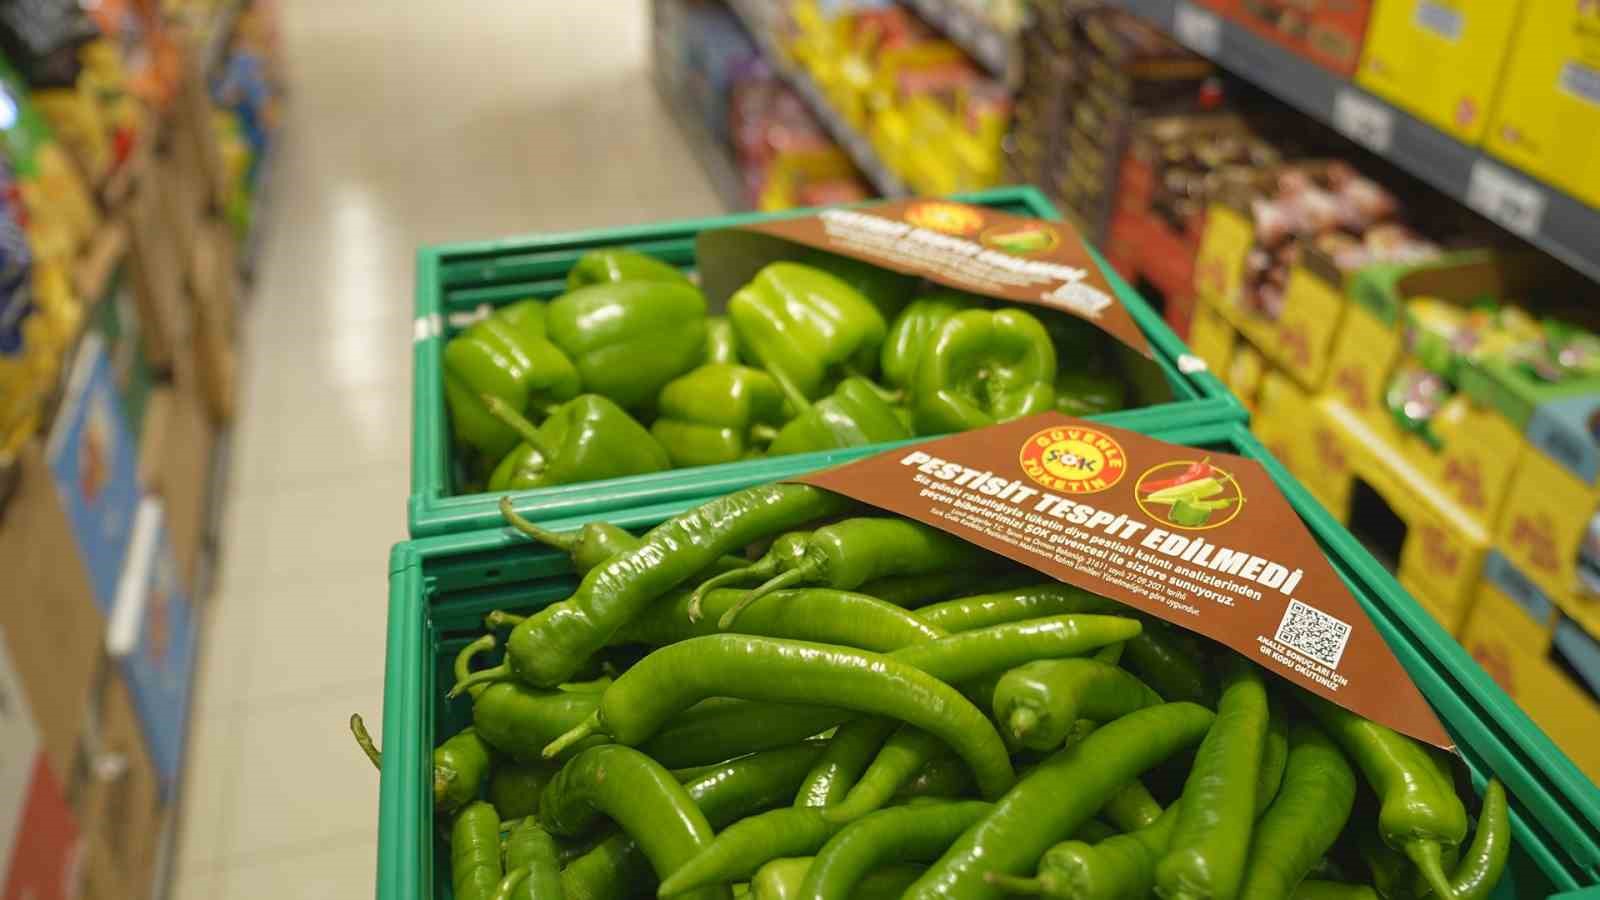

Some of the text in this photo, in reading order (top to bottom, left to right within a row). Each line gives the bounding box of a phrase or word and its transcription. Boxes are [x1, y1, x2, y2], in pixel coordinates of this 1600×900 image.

[1036, 430, 1122, 468] GÜVENLE
[1023, 458, 1106, 491] TÜKETİN
[900, 450, 1039, 504] PESTİSİT
[1033, 492, 1147, 540] TESPİT
[1141, 526, 1304, 596] EDİLMEDİ
[913, 473, 931, 486] Siz
[929, 479, 962, 498] gönül
[1024, 512, 1064, 532] tüketin
[1064, 526, 1090, 541] diye
[1088, 532, 1134, 556] pestisit
[1134, 549, 1174, 570] kalıntı
[1173, 564, 1262, 601] analizlerinden
[1024, 524, 1051, 539] ŞOK
[1048, 534, 1109, 560] güvencesi
[1108, 552, 1125, 566] ile
[1125, 560, 1167, 581] sizlere
[1167, 577, 1236, 608] sunuyoruz.
[1260, 645, 1339, 692] QR KODU OKUTUNUZ
[1286, 649, 1331, 677] SONUÇLARI
[1330, 671, 1349, 687] İÇİN
